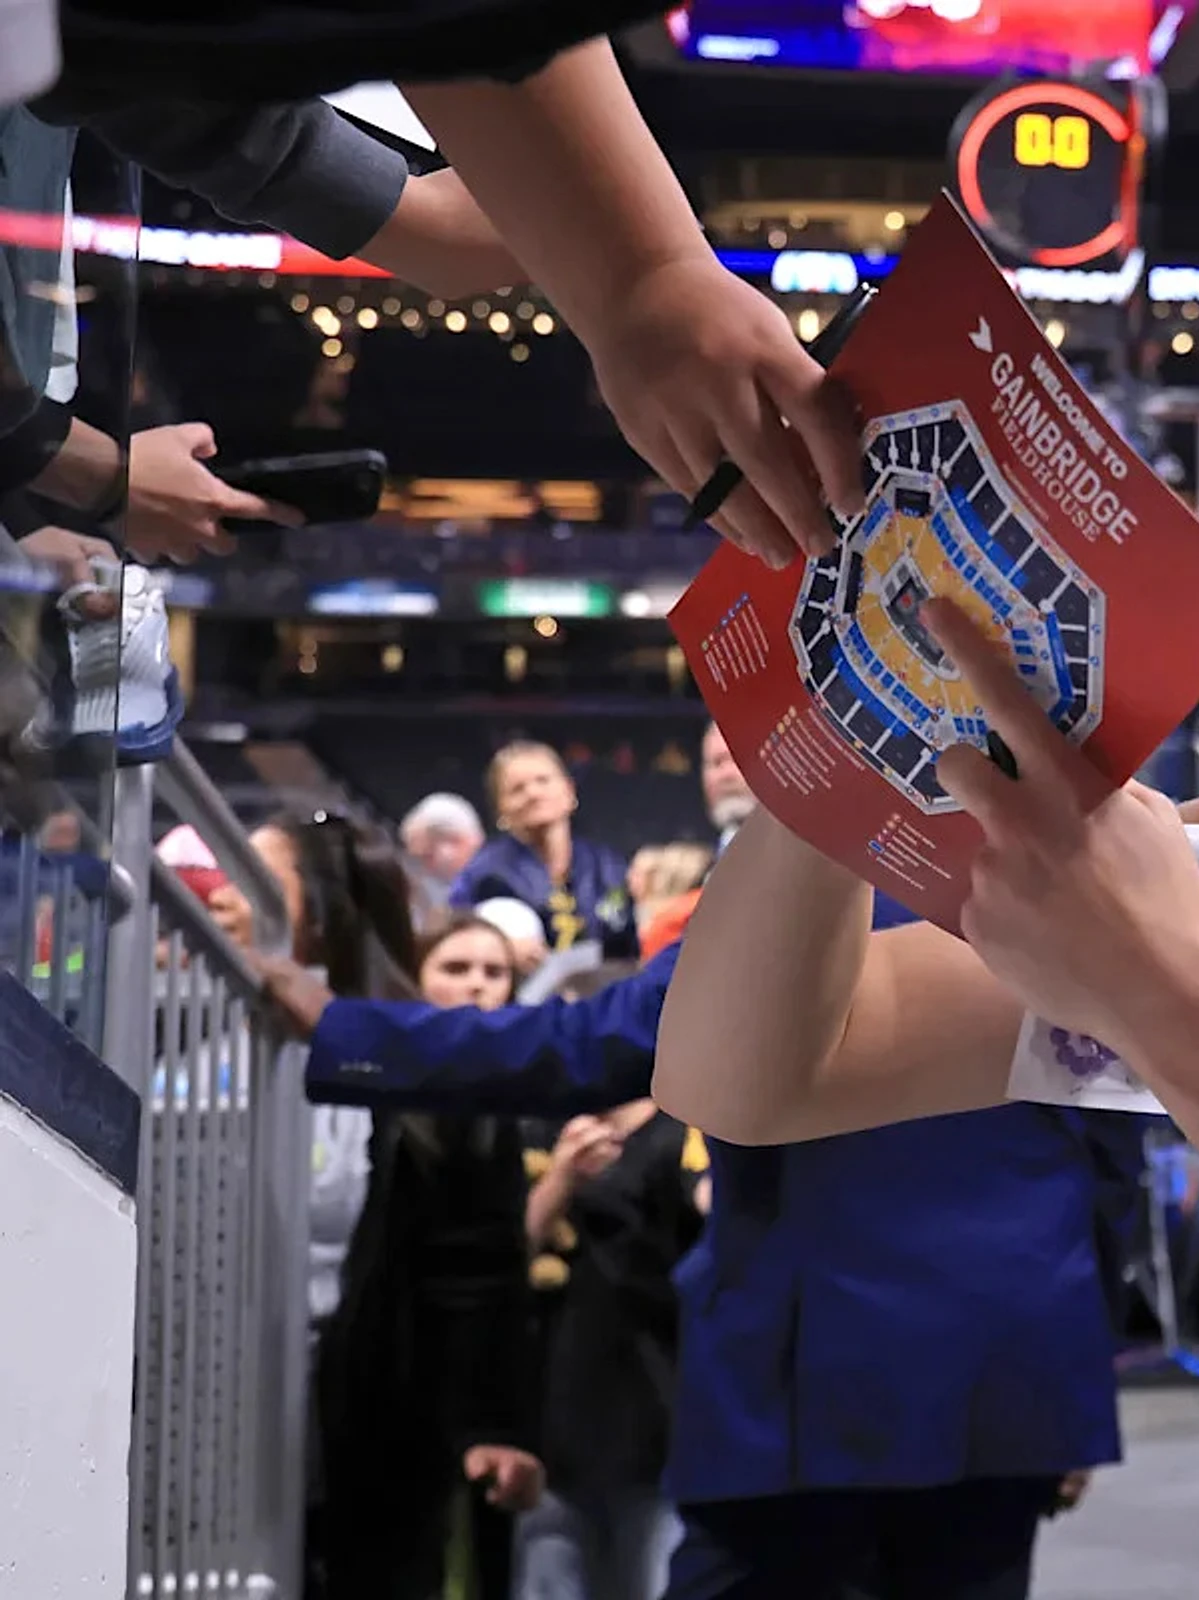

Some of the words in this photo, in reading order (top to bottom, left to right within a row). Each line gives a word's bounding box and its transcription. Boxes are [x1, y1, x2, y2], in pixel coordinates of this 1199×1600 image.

[1015, 113, 1090, 169] 00
[991, 353, 1138, 545] GAINBRIDGE
[991, 396, 1101, 543] FIELDHOUSE
[1031, 353, 1106, 456] WELCOME
[1102, 446, 1128, 480] TO
